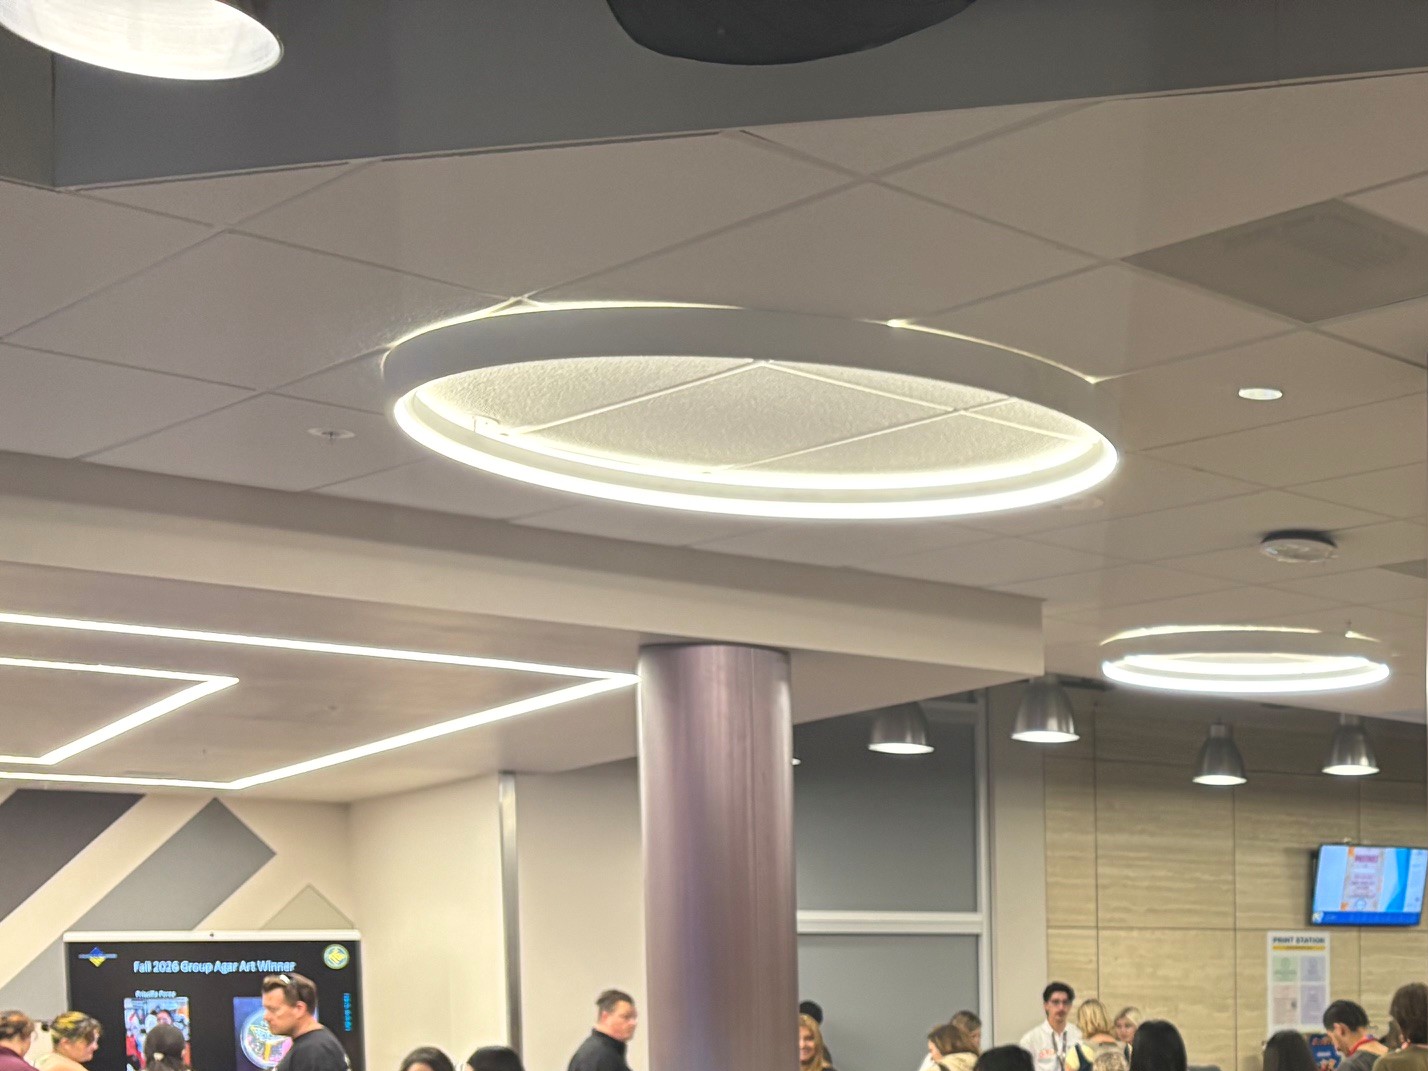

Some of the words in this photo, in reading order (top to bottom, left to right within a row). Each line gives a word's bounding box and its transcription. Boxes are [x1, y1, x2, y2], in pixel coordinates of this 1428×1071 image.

[1273, 936, 1294, 944] PRINT
[1295, 936, 1325, 944] STATION
[133, 960, 152, 973] Fall
[153, 961, 180, 973] 2026
[180, 961, 213, 975] Group
[213, 960, 239, 974] Agar
[239, 960, 257, 973] Art
[257, 960, 297, 973] Winner
